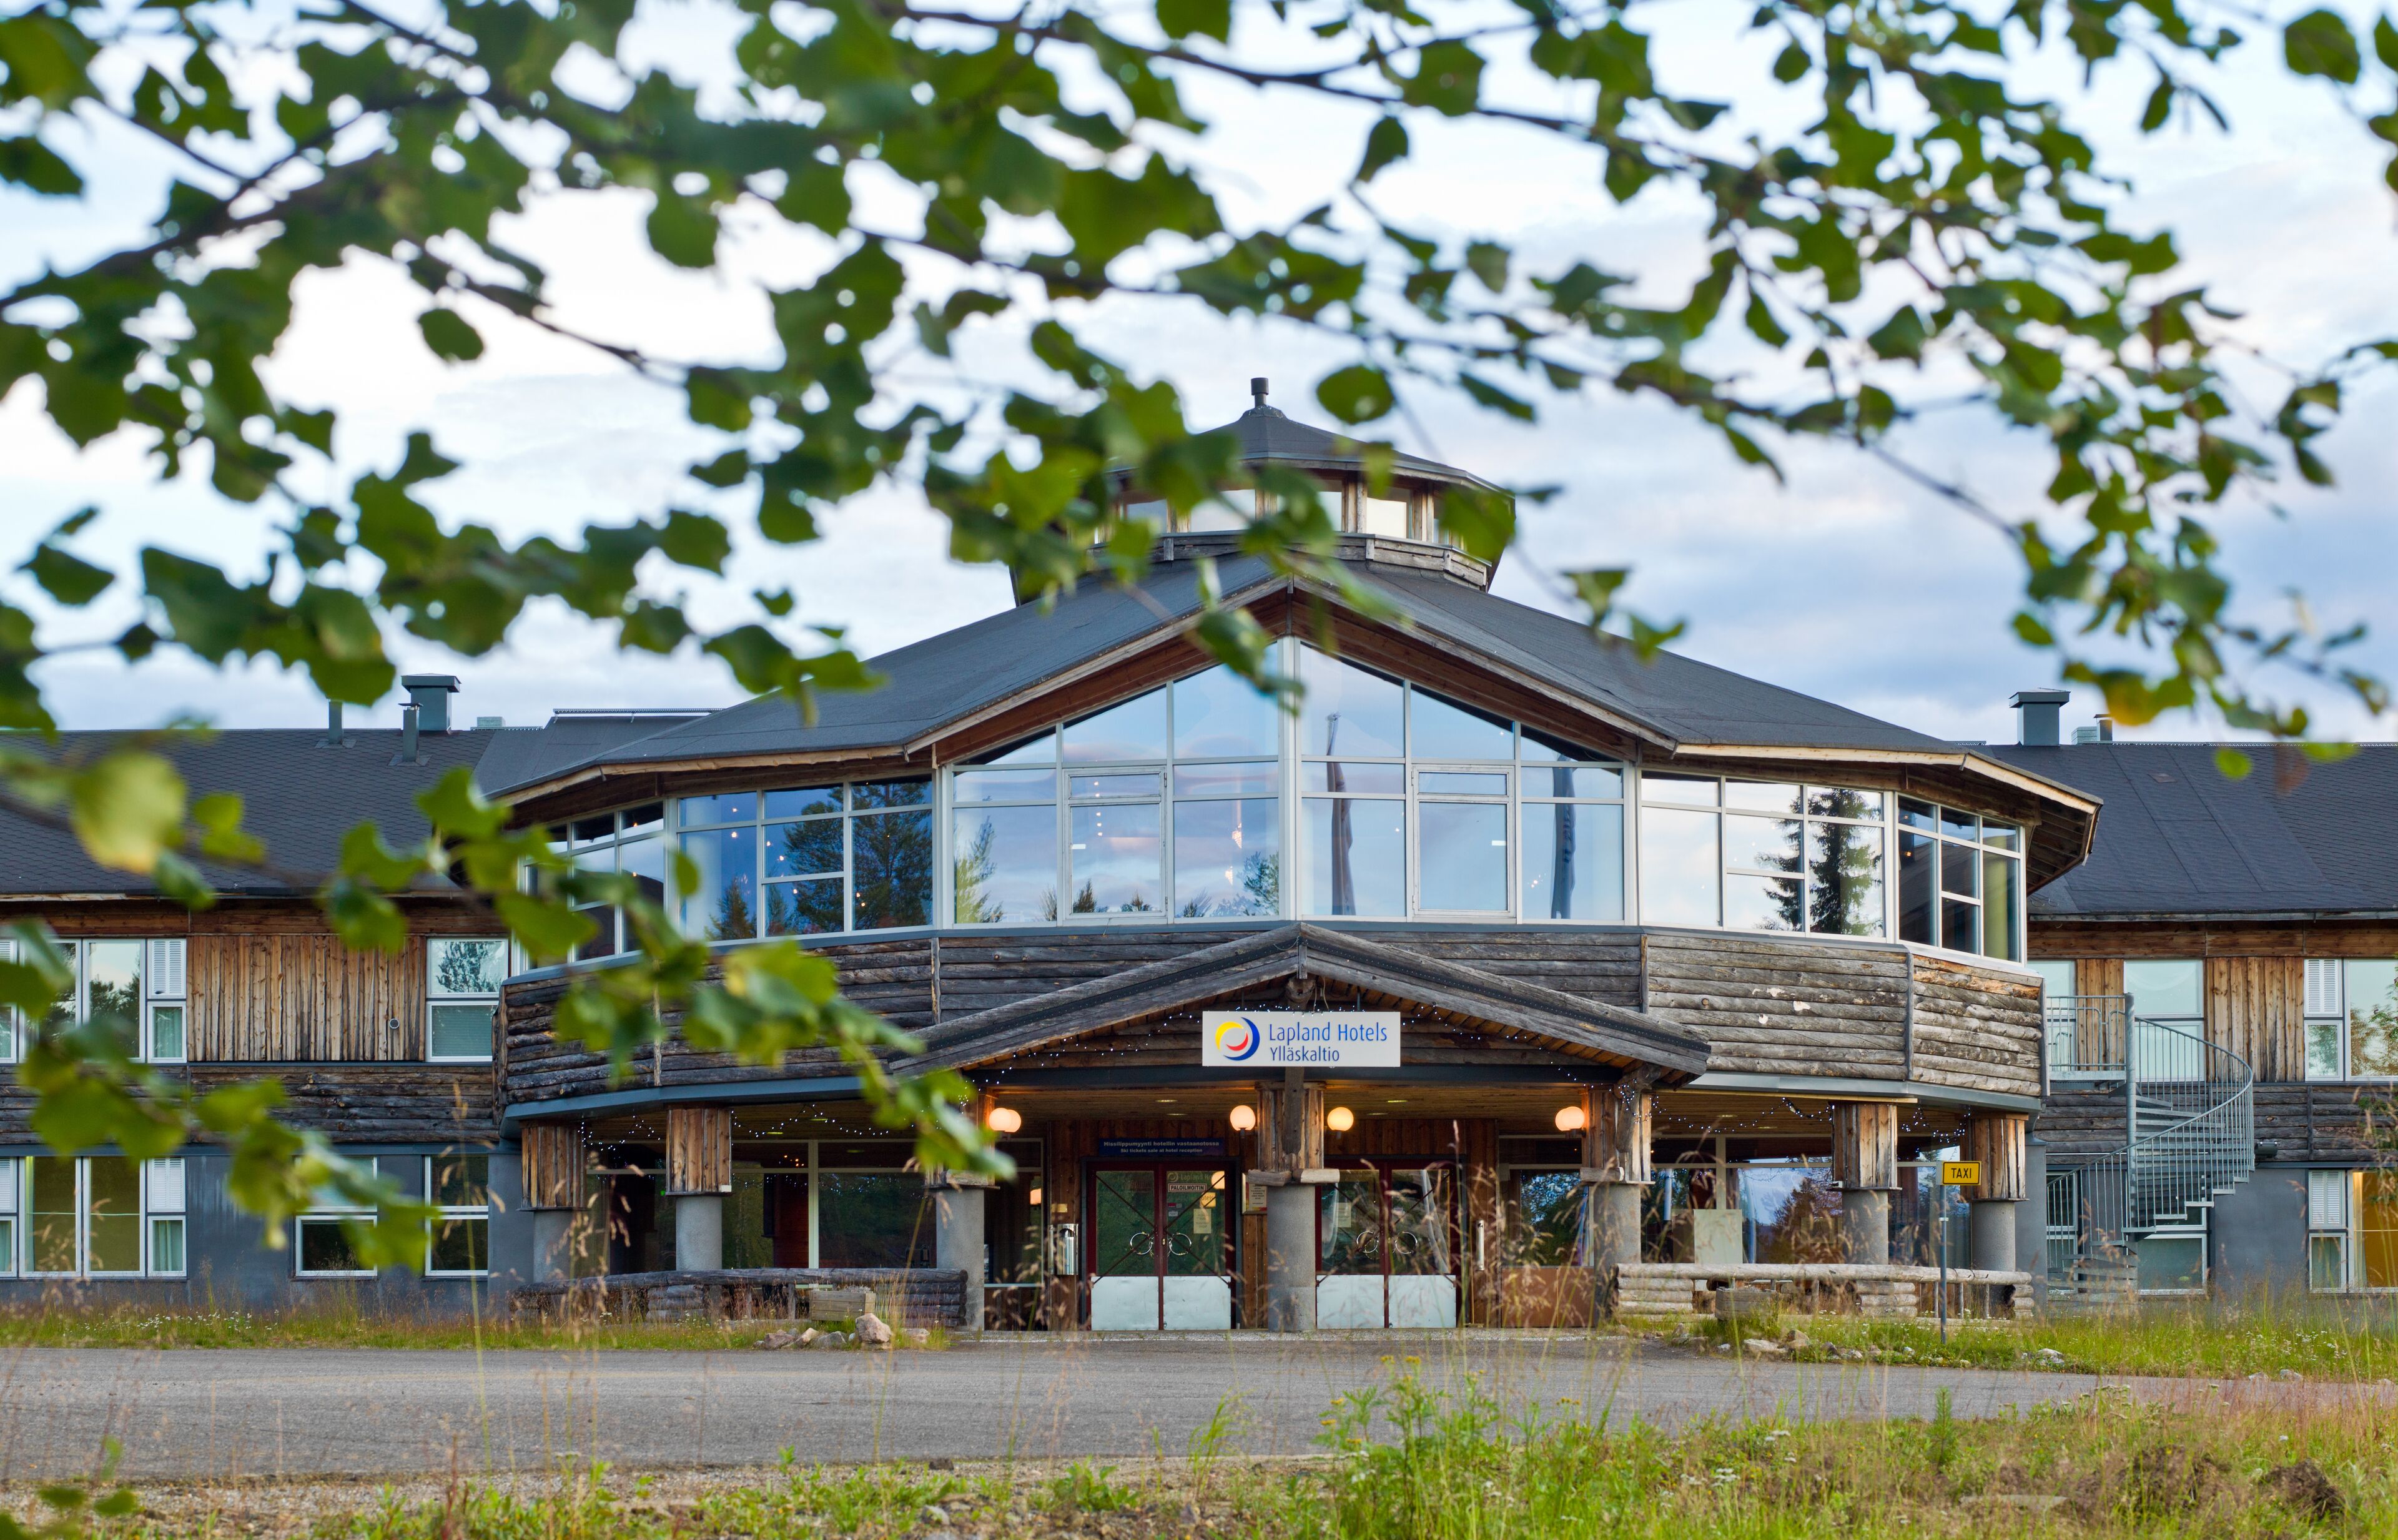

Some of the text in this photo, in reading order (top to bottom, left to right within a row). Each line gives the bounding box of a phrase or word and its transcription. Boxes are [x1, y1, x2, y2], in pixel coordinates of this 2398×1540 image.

[1270, 1022, 1388, 1045] Lapland Hotels
[1270, 1046, 1340, 1062] Ylläskaltio
[1951, 1168, 1971, 1178] TAXI
